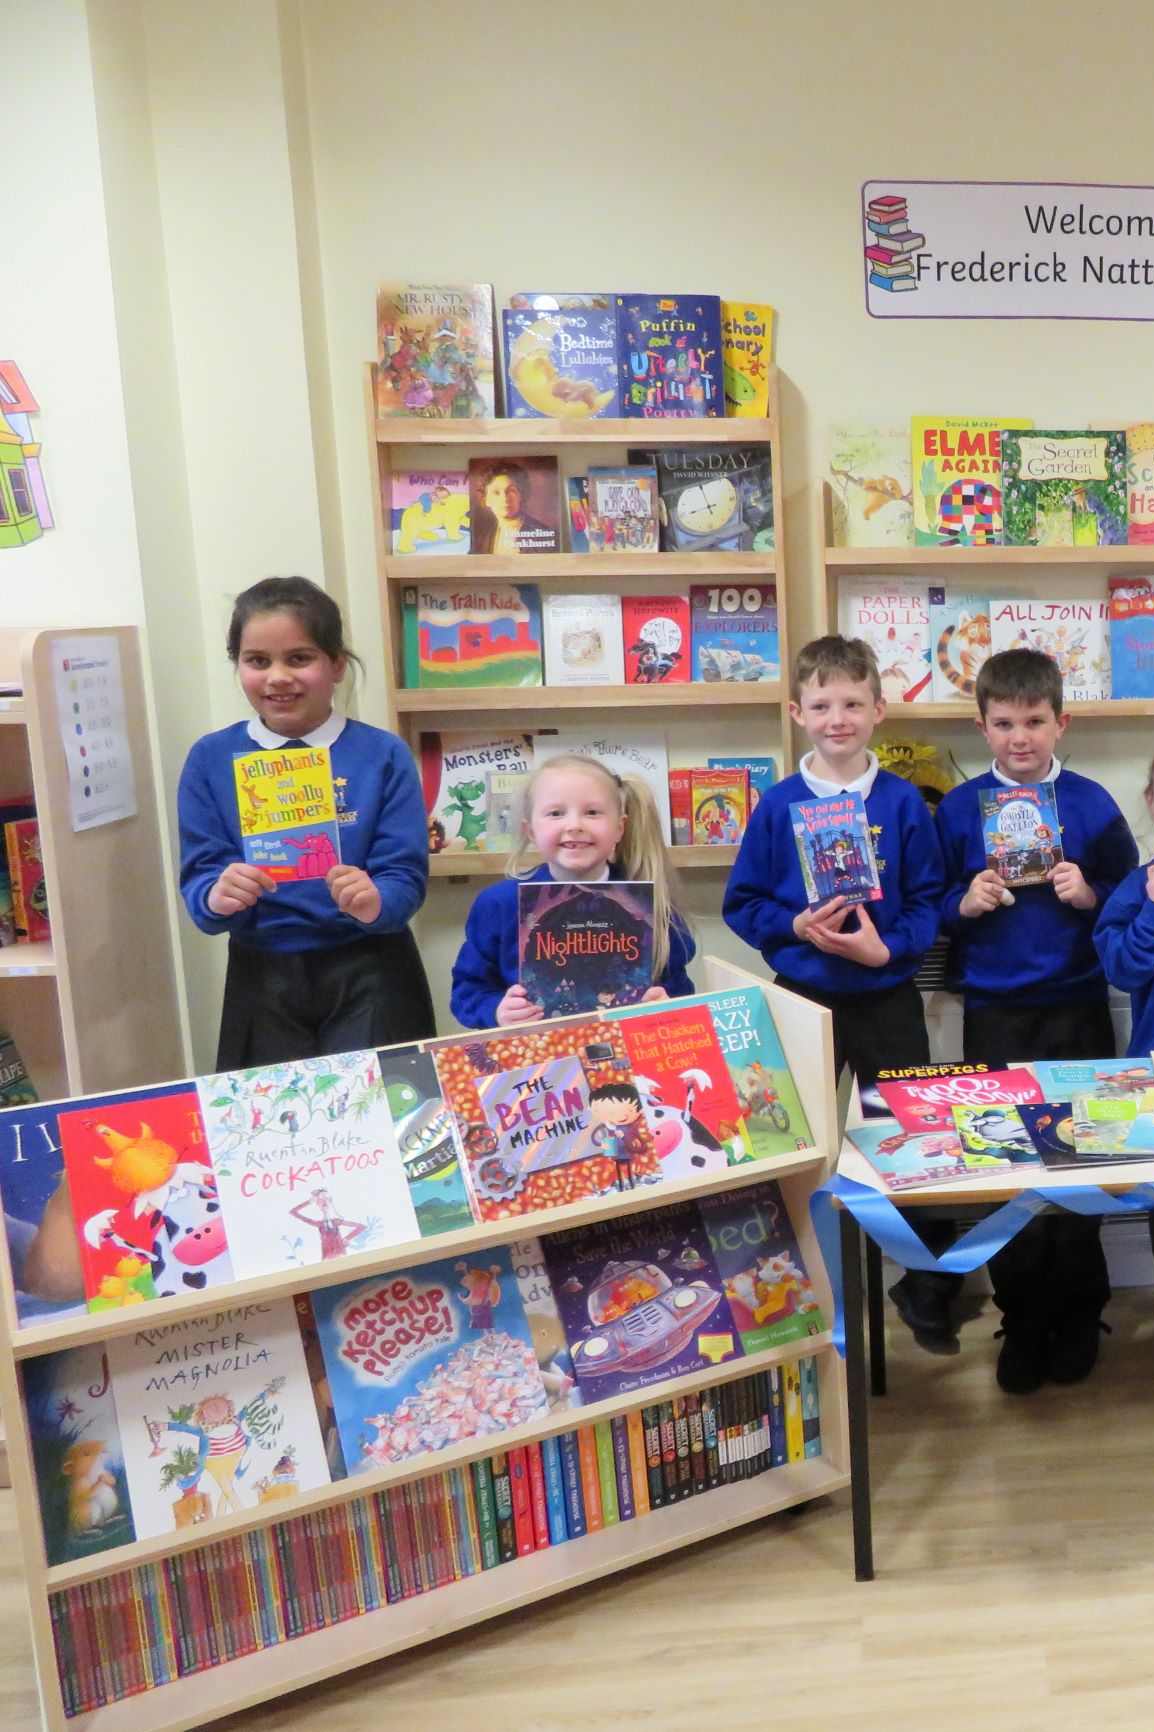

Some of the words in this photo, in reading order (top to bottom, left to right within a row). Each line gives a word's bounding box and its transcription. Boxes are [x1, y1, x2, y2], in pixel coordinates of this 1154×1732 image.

[916, 252, 1067, 284] Frederick
[394, 305, 424, 316] NEW
[639, 319, 697, 332] Puffin
[723, 319, 766, 337] chool
[559, 333, 613, 351] Bedtime
[560, 350, 613, 367] Lullabies
[1042, 442, 1098, 460] Secret
[647, 453, 751, 471] TUESDAY
[1027, 458, 1092, 475] Garden
[409, 474, 435, 487] Who
[438, 474, 459, 487] Can
[421, 593, 447, 611] The
[450, 592, 487, 611] Train
[489, 592, 523, 611] Ride
[707, 587, 762, 613] 100
[863, 596, 922, 609] PAPER
[857, 610, 930, 625] DOLLS
[994, 604, 1035, 622] ALL
[1041, 603, 1092, 621] JOIN
[693, 621, 778, 633] EXPLORERS
[240, 751, 325, 783] jellyphants
[277, 778, 294, 790] and
[276, 784, 324, 806] woolly
[265, 802, 332, 828] jumpers
[713, 1008, 752, 1032] AZY
[629, 1030, 657, 1046] The
[657, 1022, 706, 1040] Chicken
[717, 1028, 761, 1055] EEP!
[633, 1046, 661, 1061] that
[661, 1032, 713, 1055] Hatched
[655, 1062, 665, 1073] a
[665, 1052, 699, 1070] Cow!
[876, 1063, 990, 1079] SUPERPIGS
[511, 1076, 555, 1094] THE
[494, 1086, 585, 1133] BEAN
[509, 1117, 589, 1149] MACHINE
[245, 1142, 316, 1169] Quentin
[317, 1134, 371, 1157] Blake
[240, 1148, 385, 1197] COCKATOOS
[634, 1223, 676, 1250] World
[343, 1279, 414, 1332] more
[134, 1314, 212, 1347] Quentin
[155, 1331, 260, 1365] MISTER
[145, 1348, 274, 1392] MAGNOLIA
